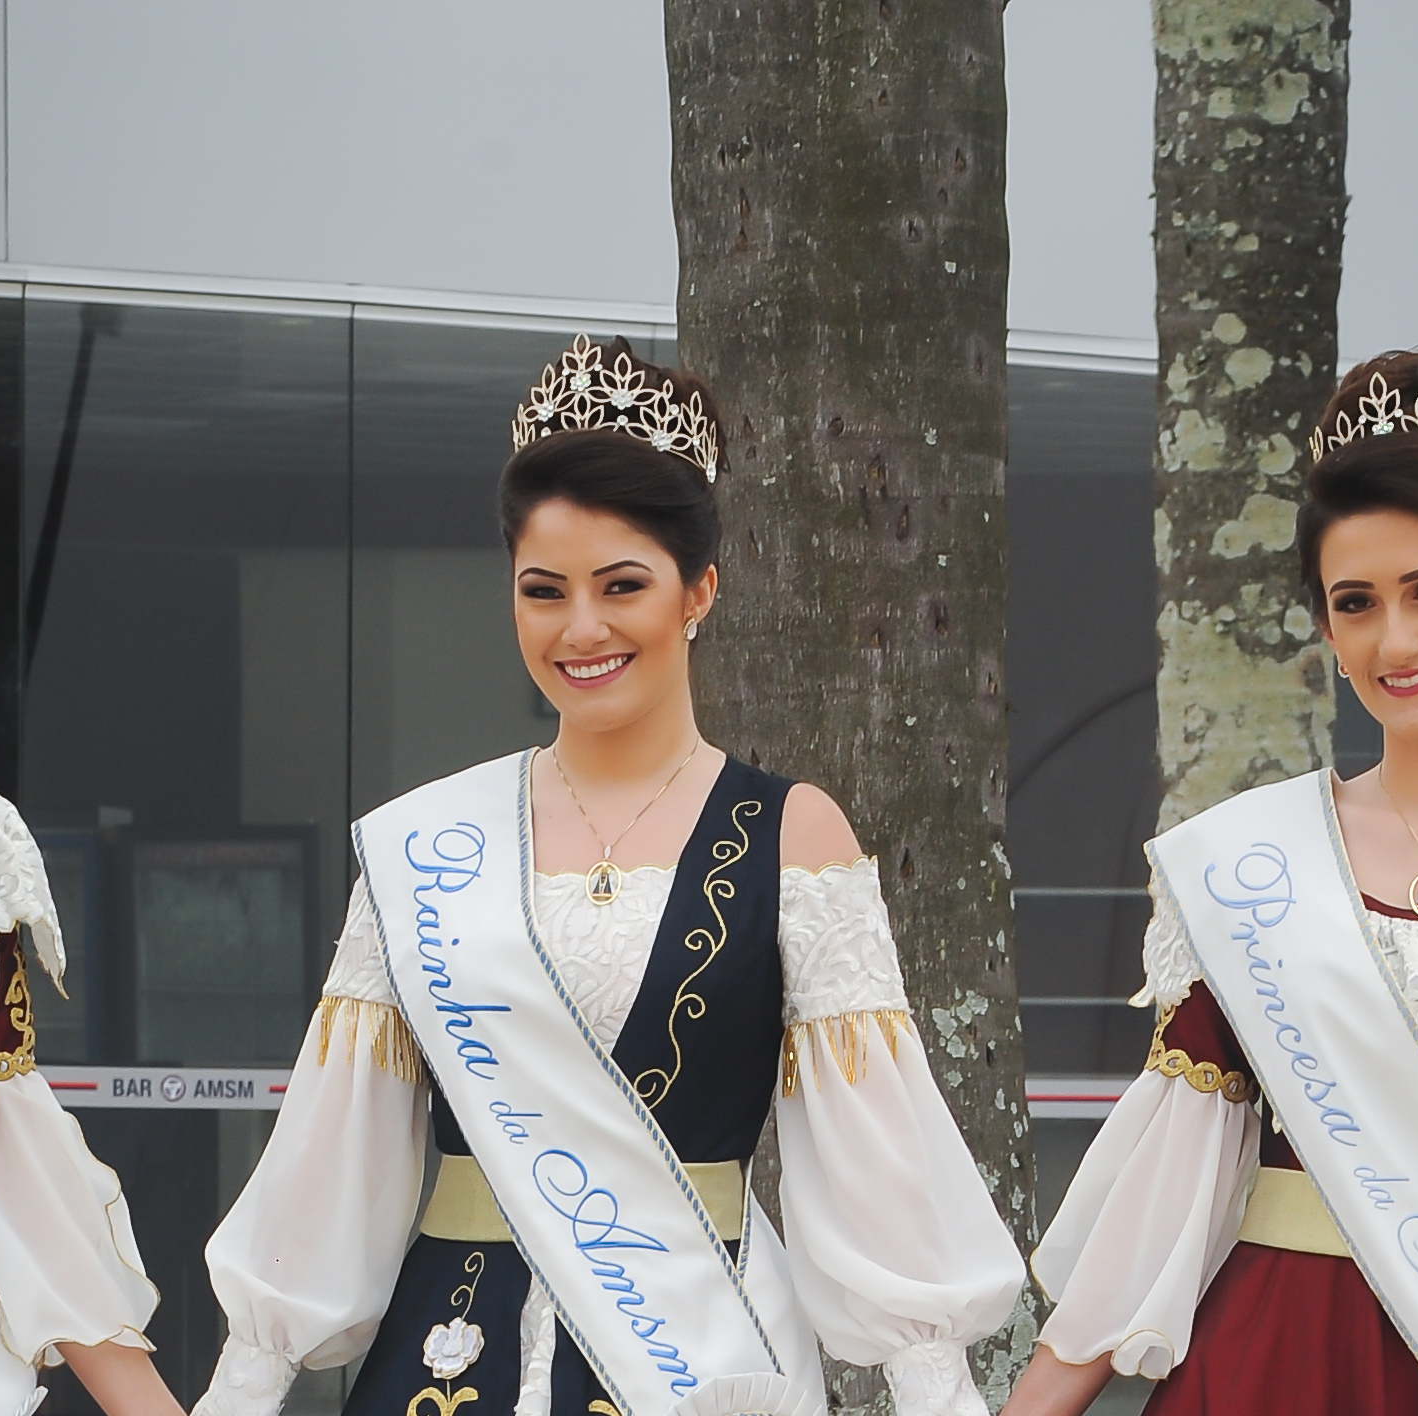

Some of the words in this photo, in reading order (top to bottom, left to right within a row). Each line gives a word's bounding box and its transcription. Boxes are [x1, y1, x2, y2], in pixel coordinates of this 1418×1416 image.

[113, 1078, 152, 1098] BAR
[194, 1079, 254, 1099] AMSM
[405, 821, 511, 1081] Rainha
[488, 1099, 543, 1145] da
[532, 1149, 701, 1398] Amsm
[1204, 842, 1363, 1148] Princesa
[1354, 1164, 1410, 1211] da
